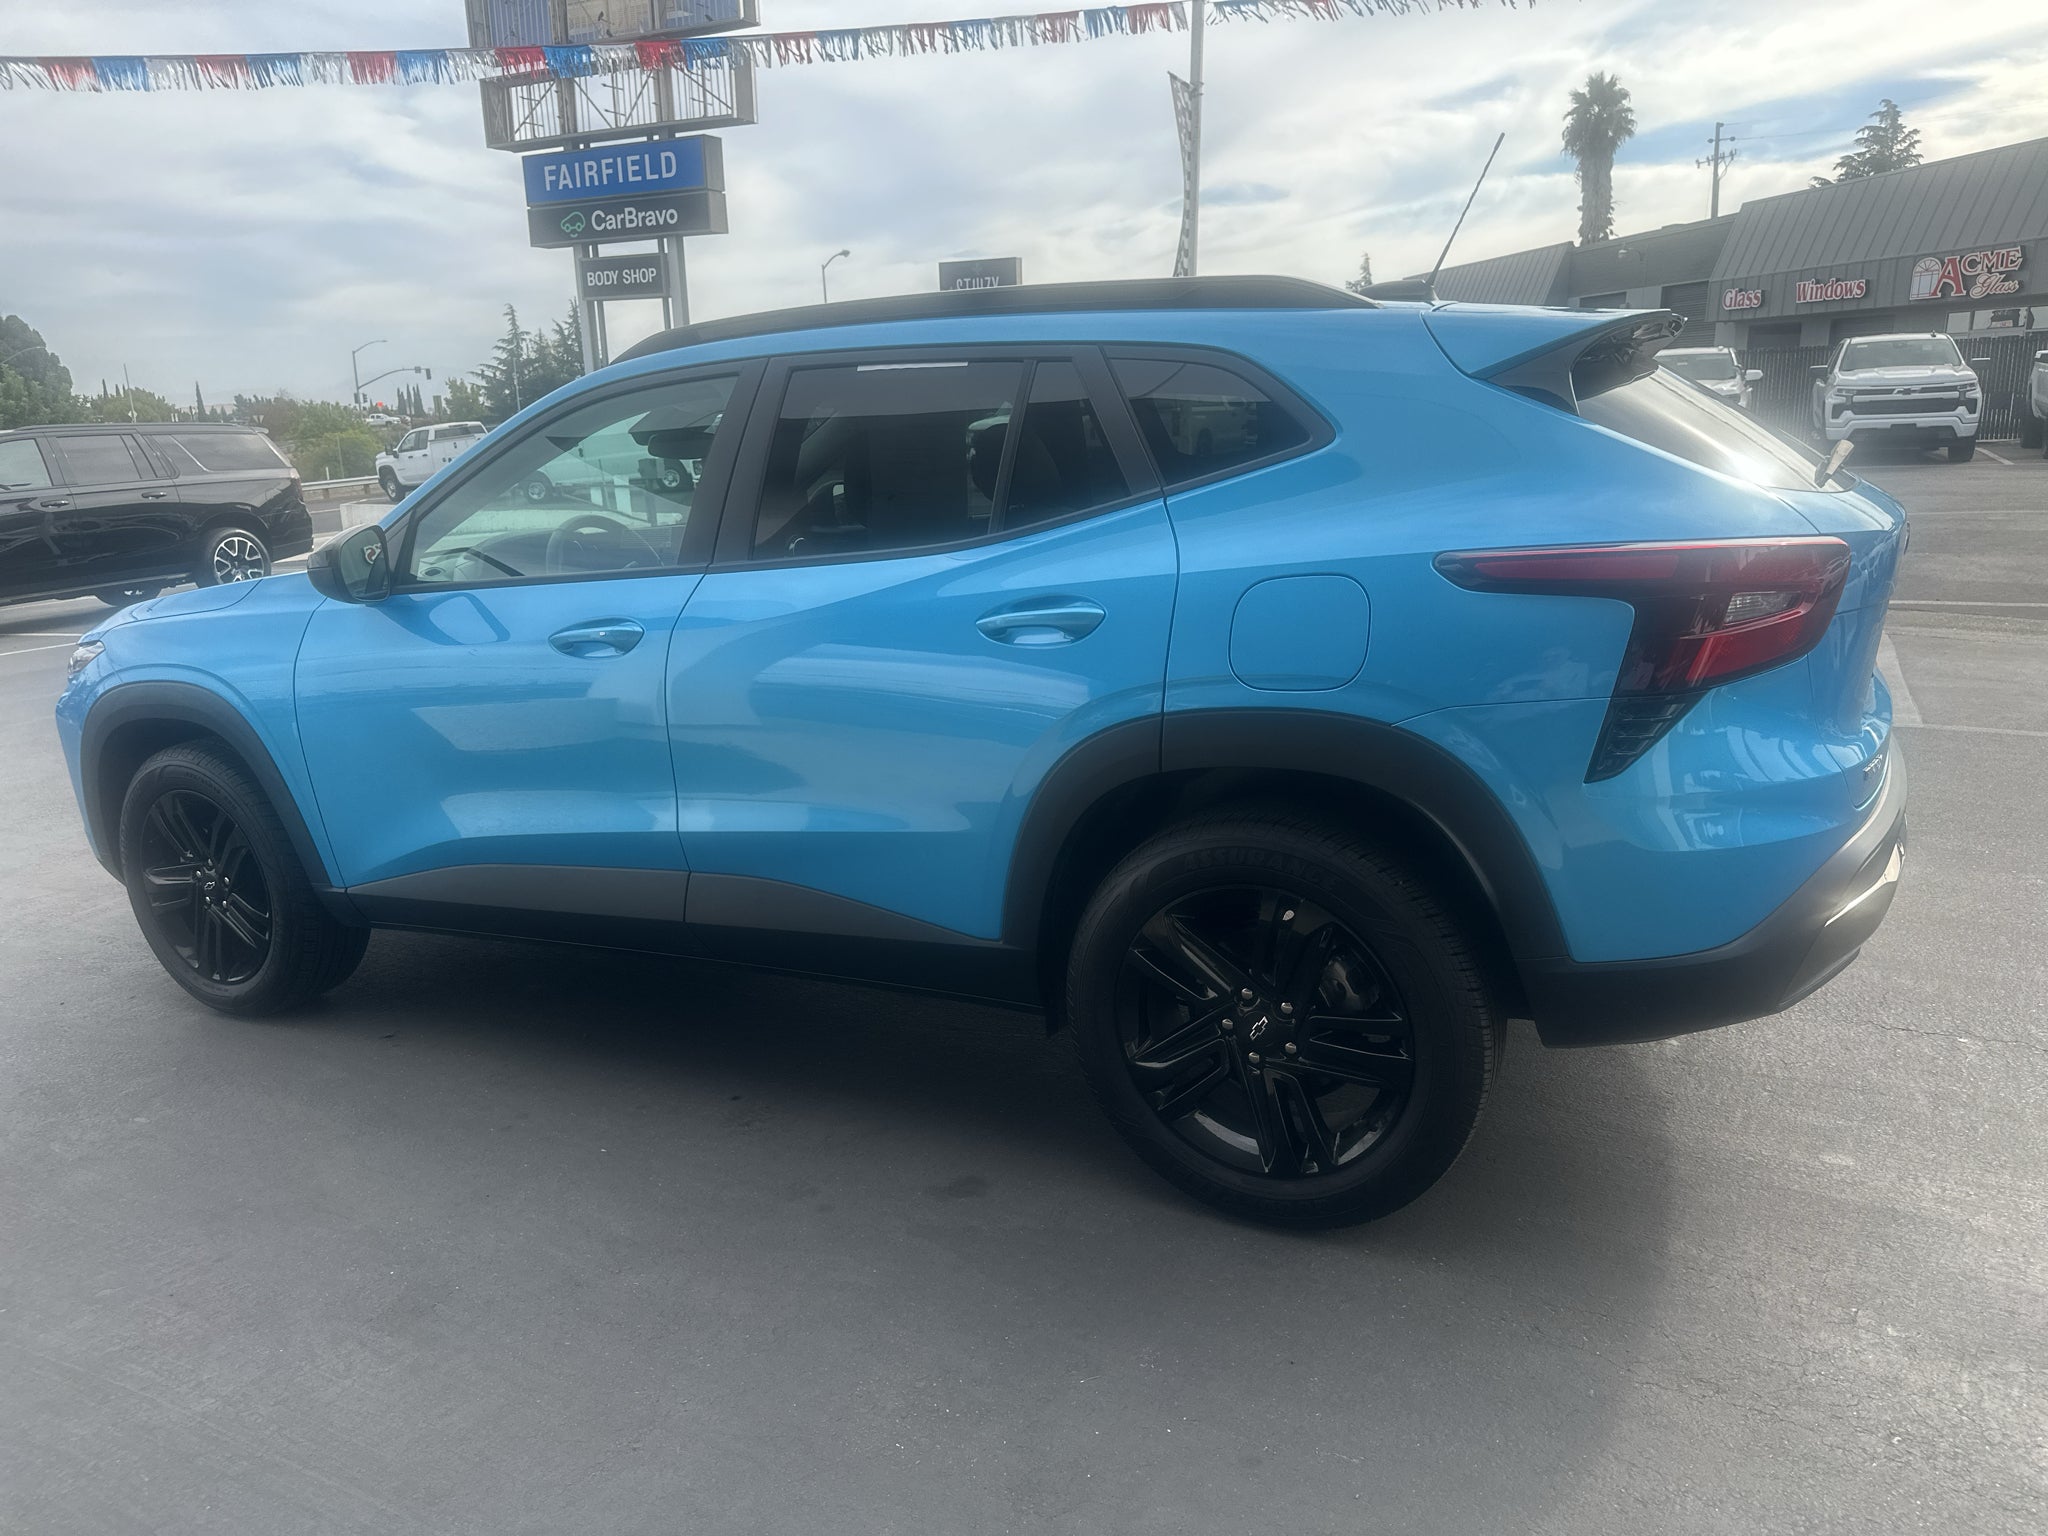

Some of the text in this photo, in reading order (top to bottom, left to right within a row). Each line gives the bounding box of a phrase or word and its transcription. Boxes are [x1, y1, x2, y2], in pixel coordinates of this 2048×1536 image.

[544, 151, 677, 191] FAIRFIELD
[591, 206, 678, 231] CarBravo
[586, 268, 657, 286] BODY SHOP
[1931, 246, 2023, 298] ACME
[1722, 288, 1763, 310] Glass
[1795, 277, 1866, 304] Windows
[1970, 273, 2019, 299] Glass
